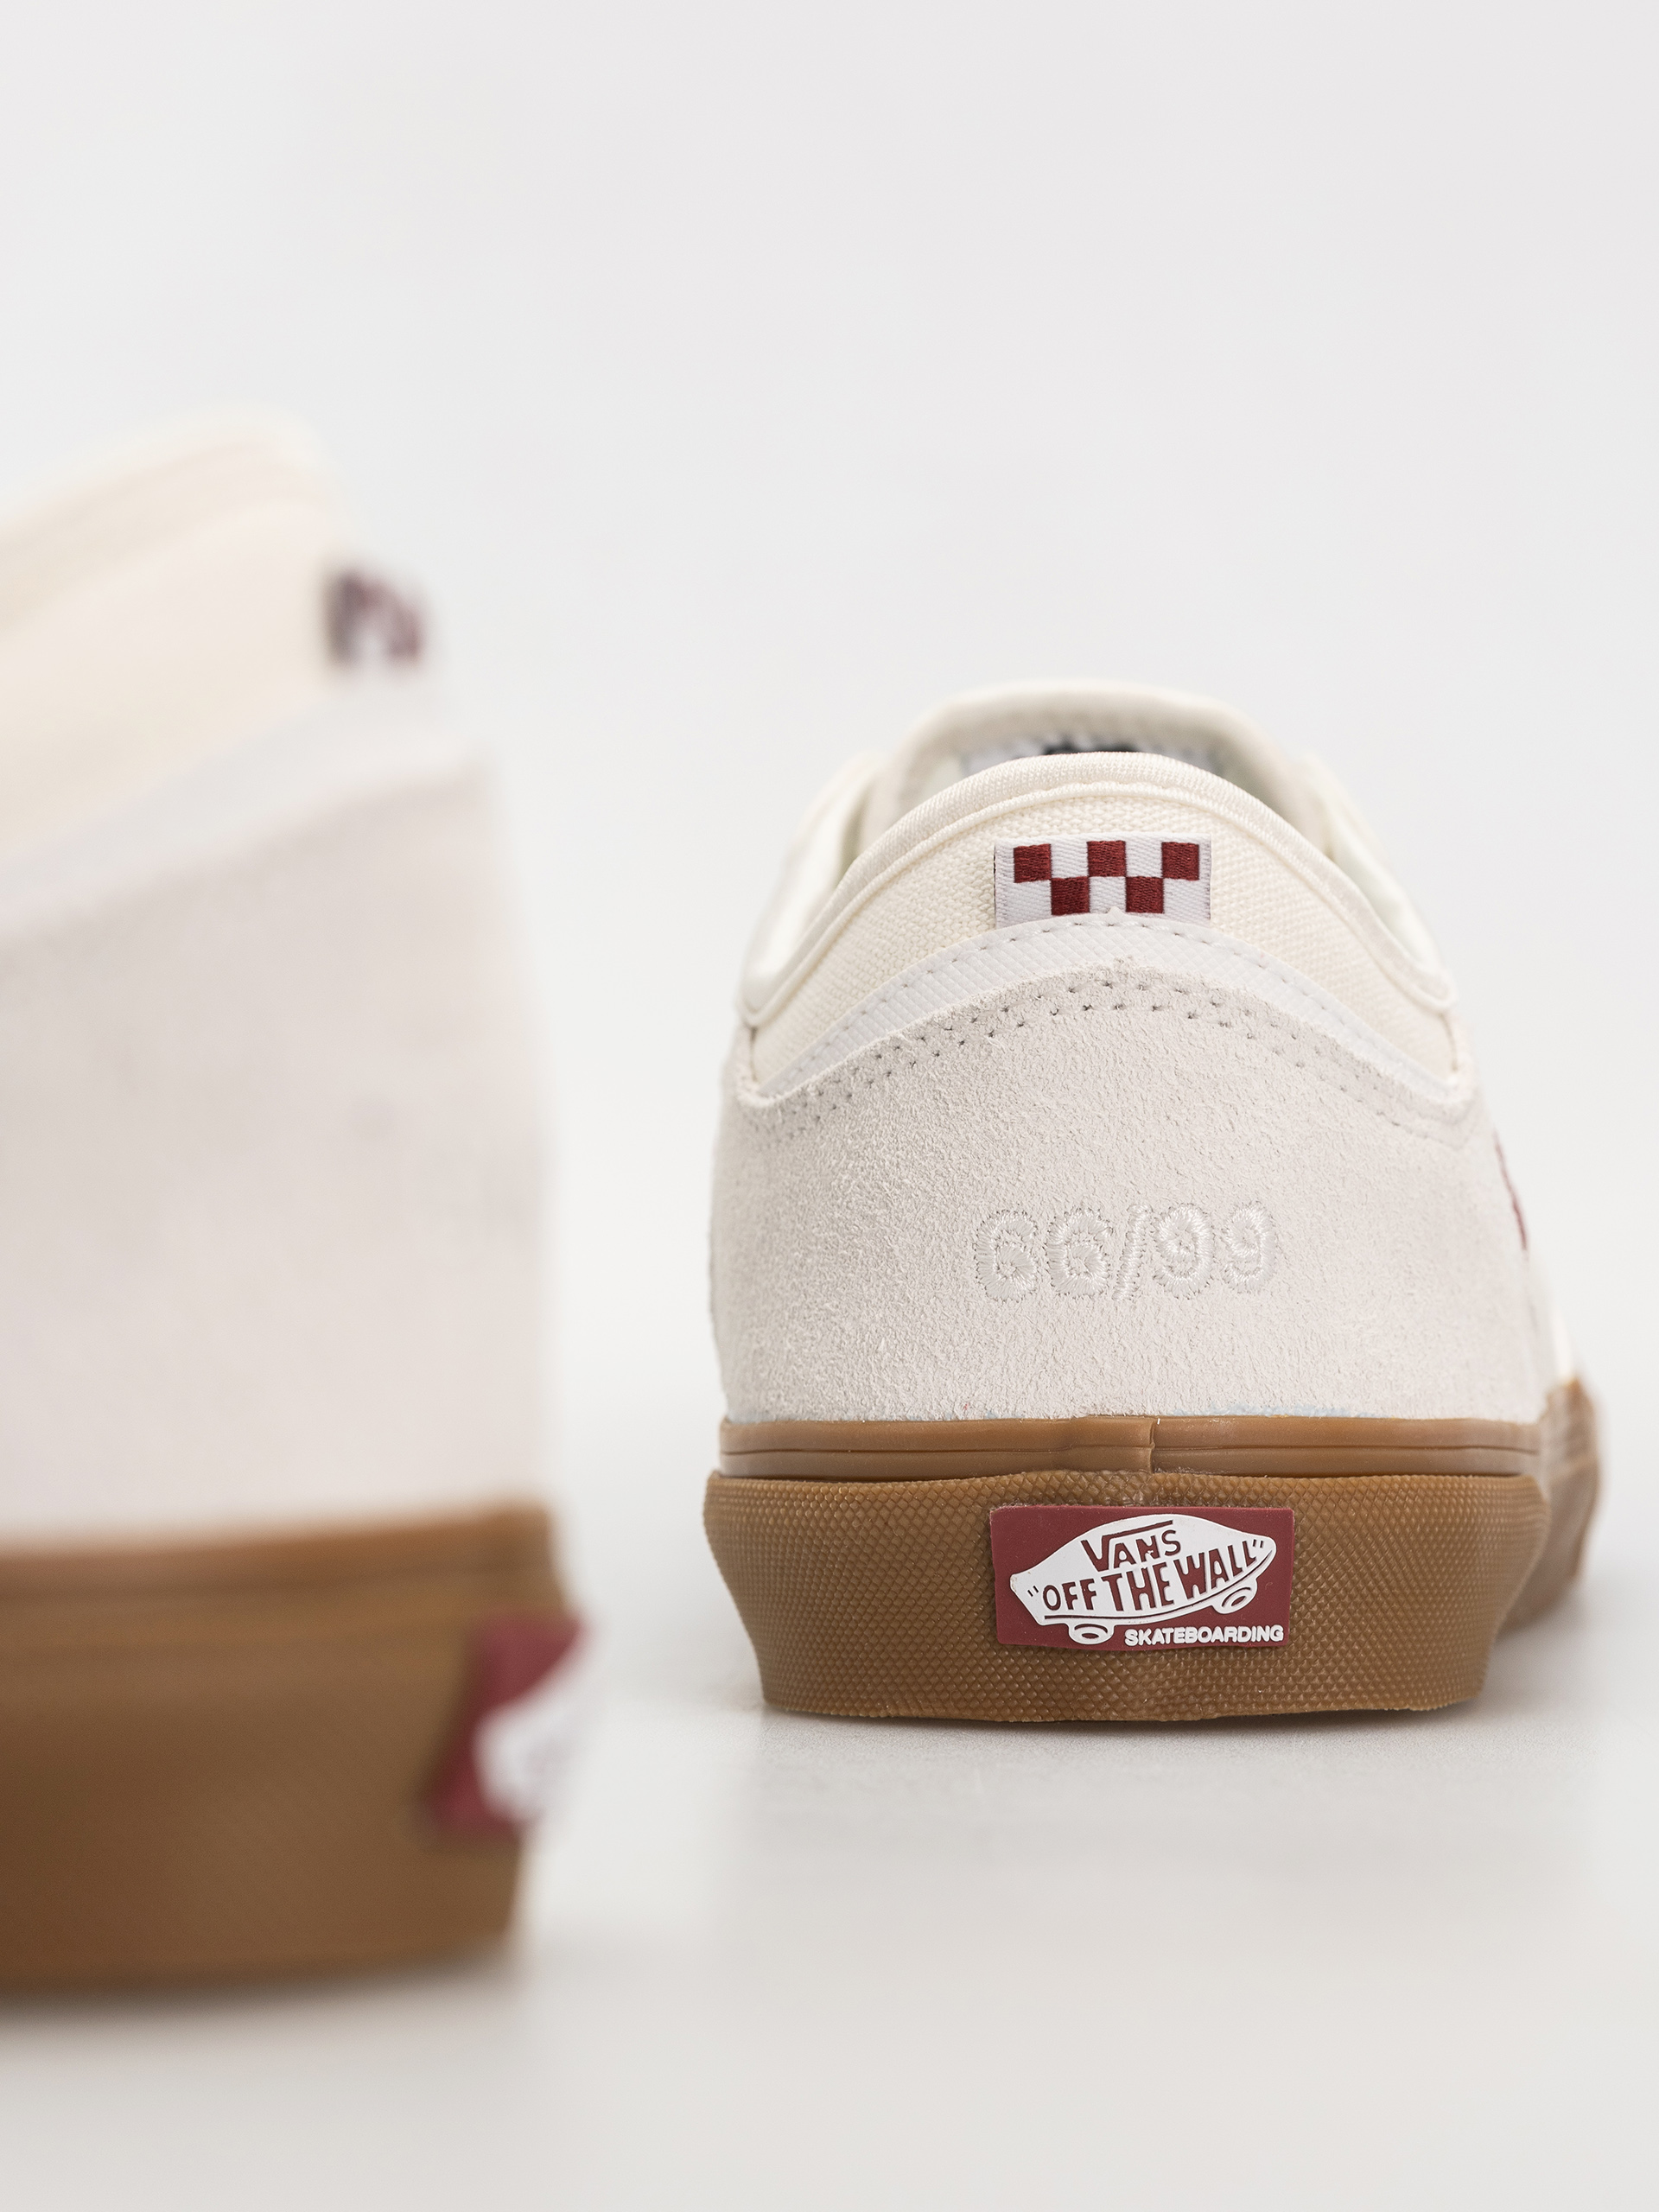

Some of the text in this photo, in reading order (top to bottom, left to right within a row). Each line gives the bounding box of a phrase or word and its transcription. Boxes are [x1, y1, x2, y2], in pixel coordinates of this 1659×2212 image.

[974, 1200, 1279, 1302] 66/99
[1027, 1539, 1264, 1612] "OFF THE WALL"
[1080, 1519, 1181, 1573] VANS
[1124, 1624, 1285, 1646] SKATEBOARDING
